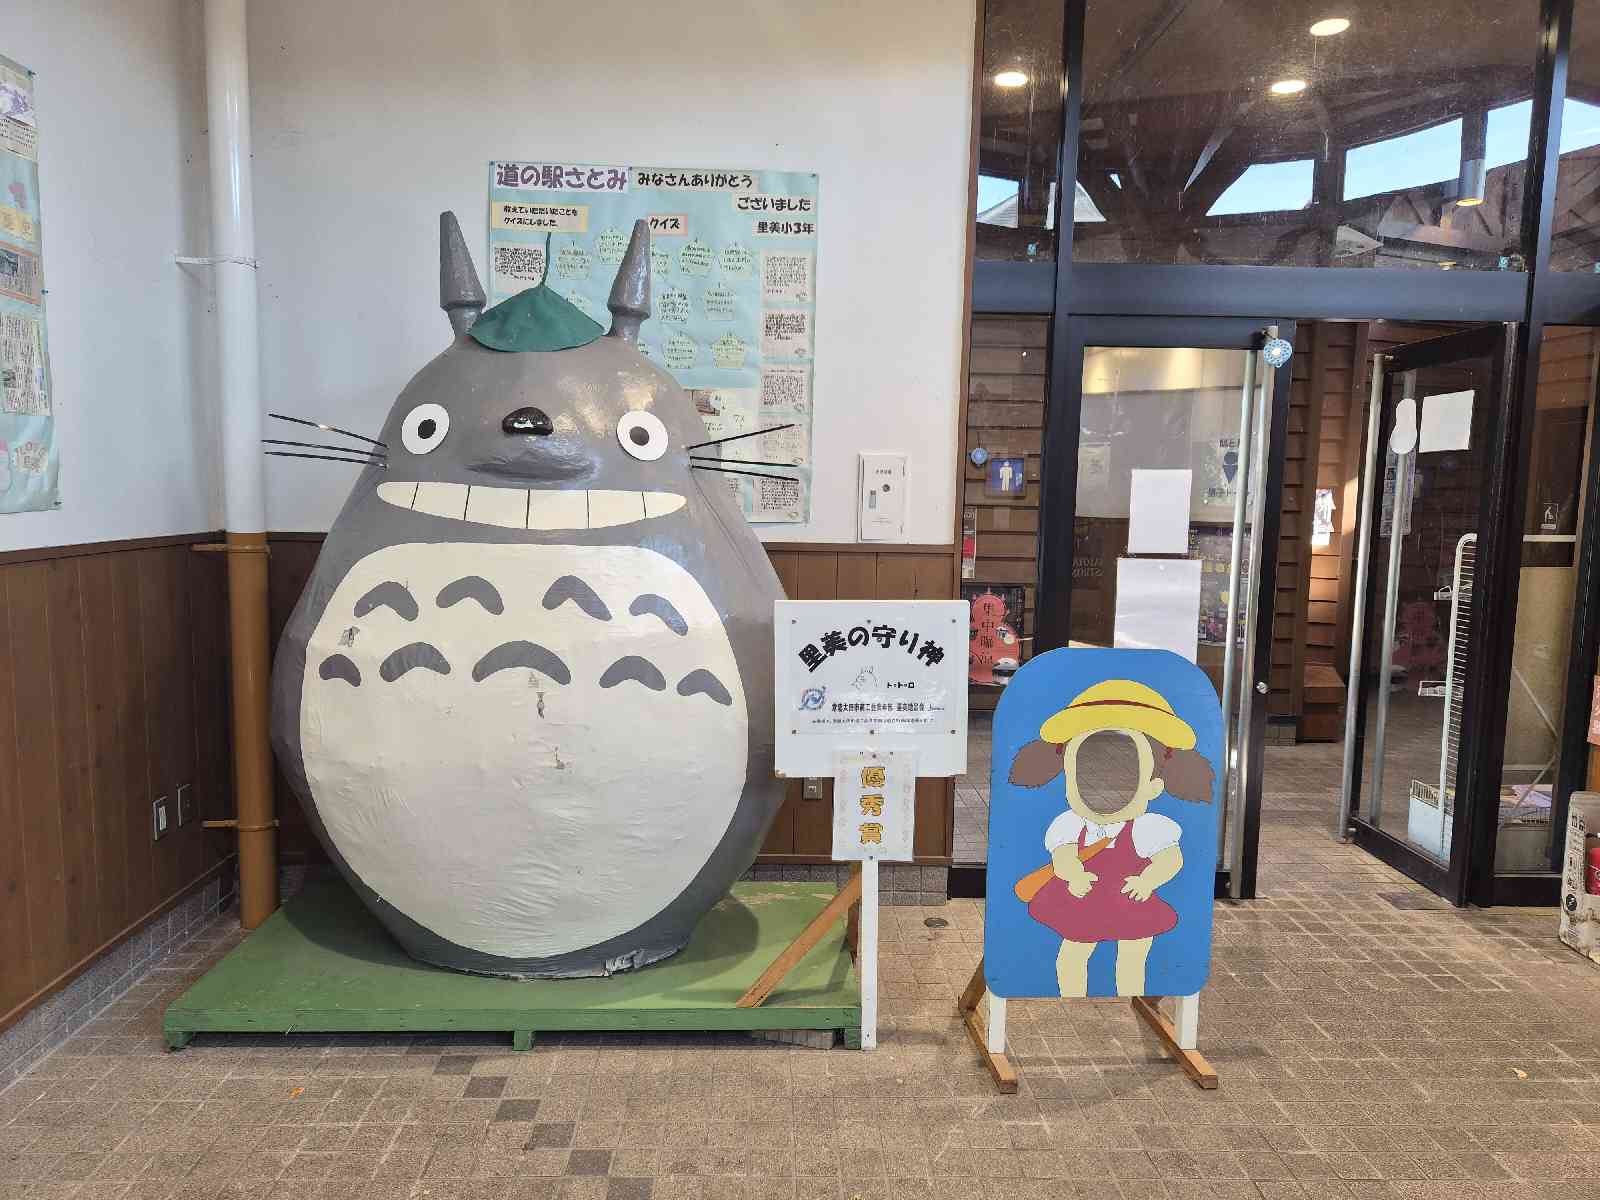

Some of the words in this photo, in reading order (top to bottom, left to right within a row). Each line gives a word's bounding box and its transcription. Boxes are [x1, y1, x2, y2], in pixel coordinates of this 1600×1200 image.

[496, 164, 628, 190] 道の駅さとみ
[638, 172, 753, 188] みなさんありがとう
[737, 197, 812, 212] ございました
[649, 217, 681, 230] クイズ
[757, 220, 815, 235] 里美小3年
[798, 624, 945, 672] 里美の守り神
[859, 766, 886, 844] 優秀賞
